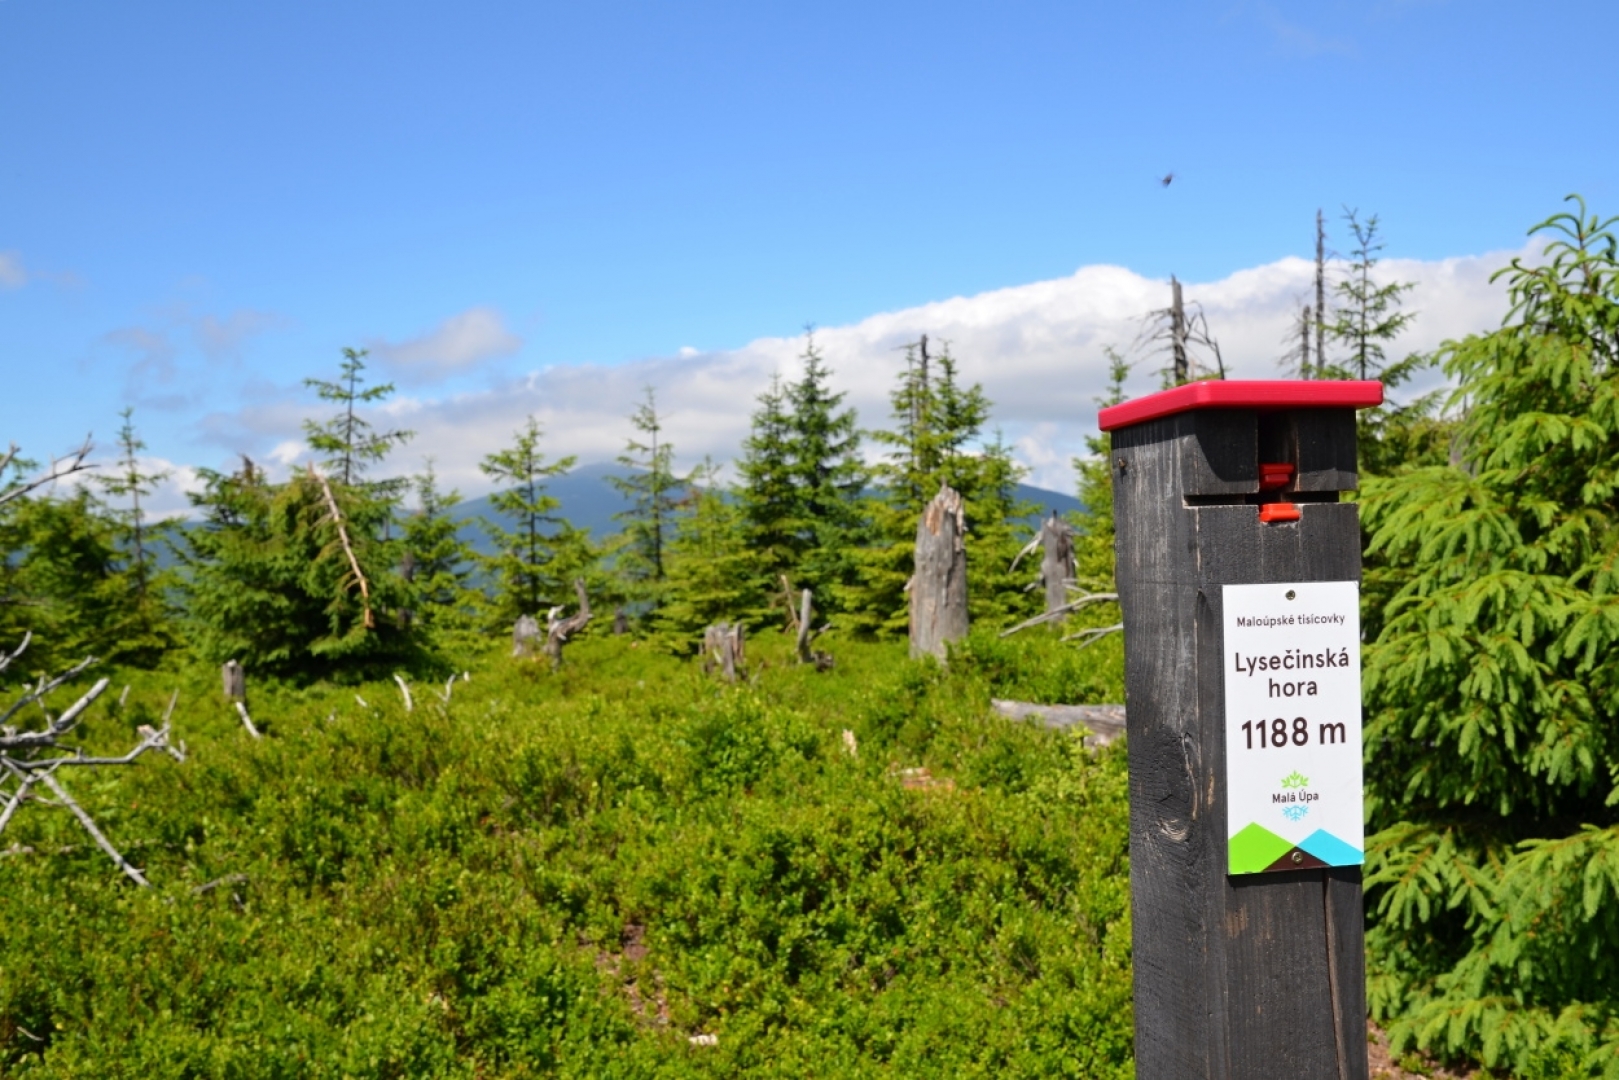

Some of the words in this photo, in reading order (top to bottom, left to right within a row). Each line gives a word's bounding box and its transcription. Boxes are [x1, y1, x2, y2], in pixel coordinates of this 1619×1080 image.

[1236, 614, 1295, 628] Maloúpské
[1297, 613, 1345, 626] tisícovky
[1235, 647, 1349, 677] Lysečinská
[1268, 677, 1318, 699] hora
[1241, 716, 1309, 750] 1188
[1319, 722, 1347, 746] m
[1272, 792, 1296, 804] Malá
[1298, 788, 1320, 804] Úpa
